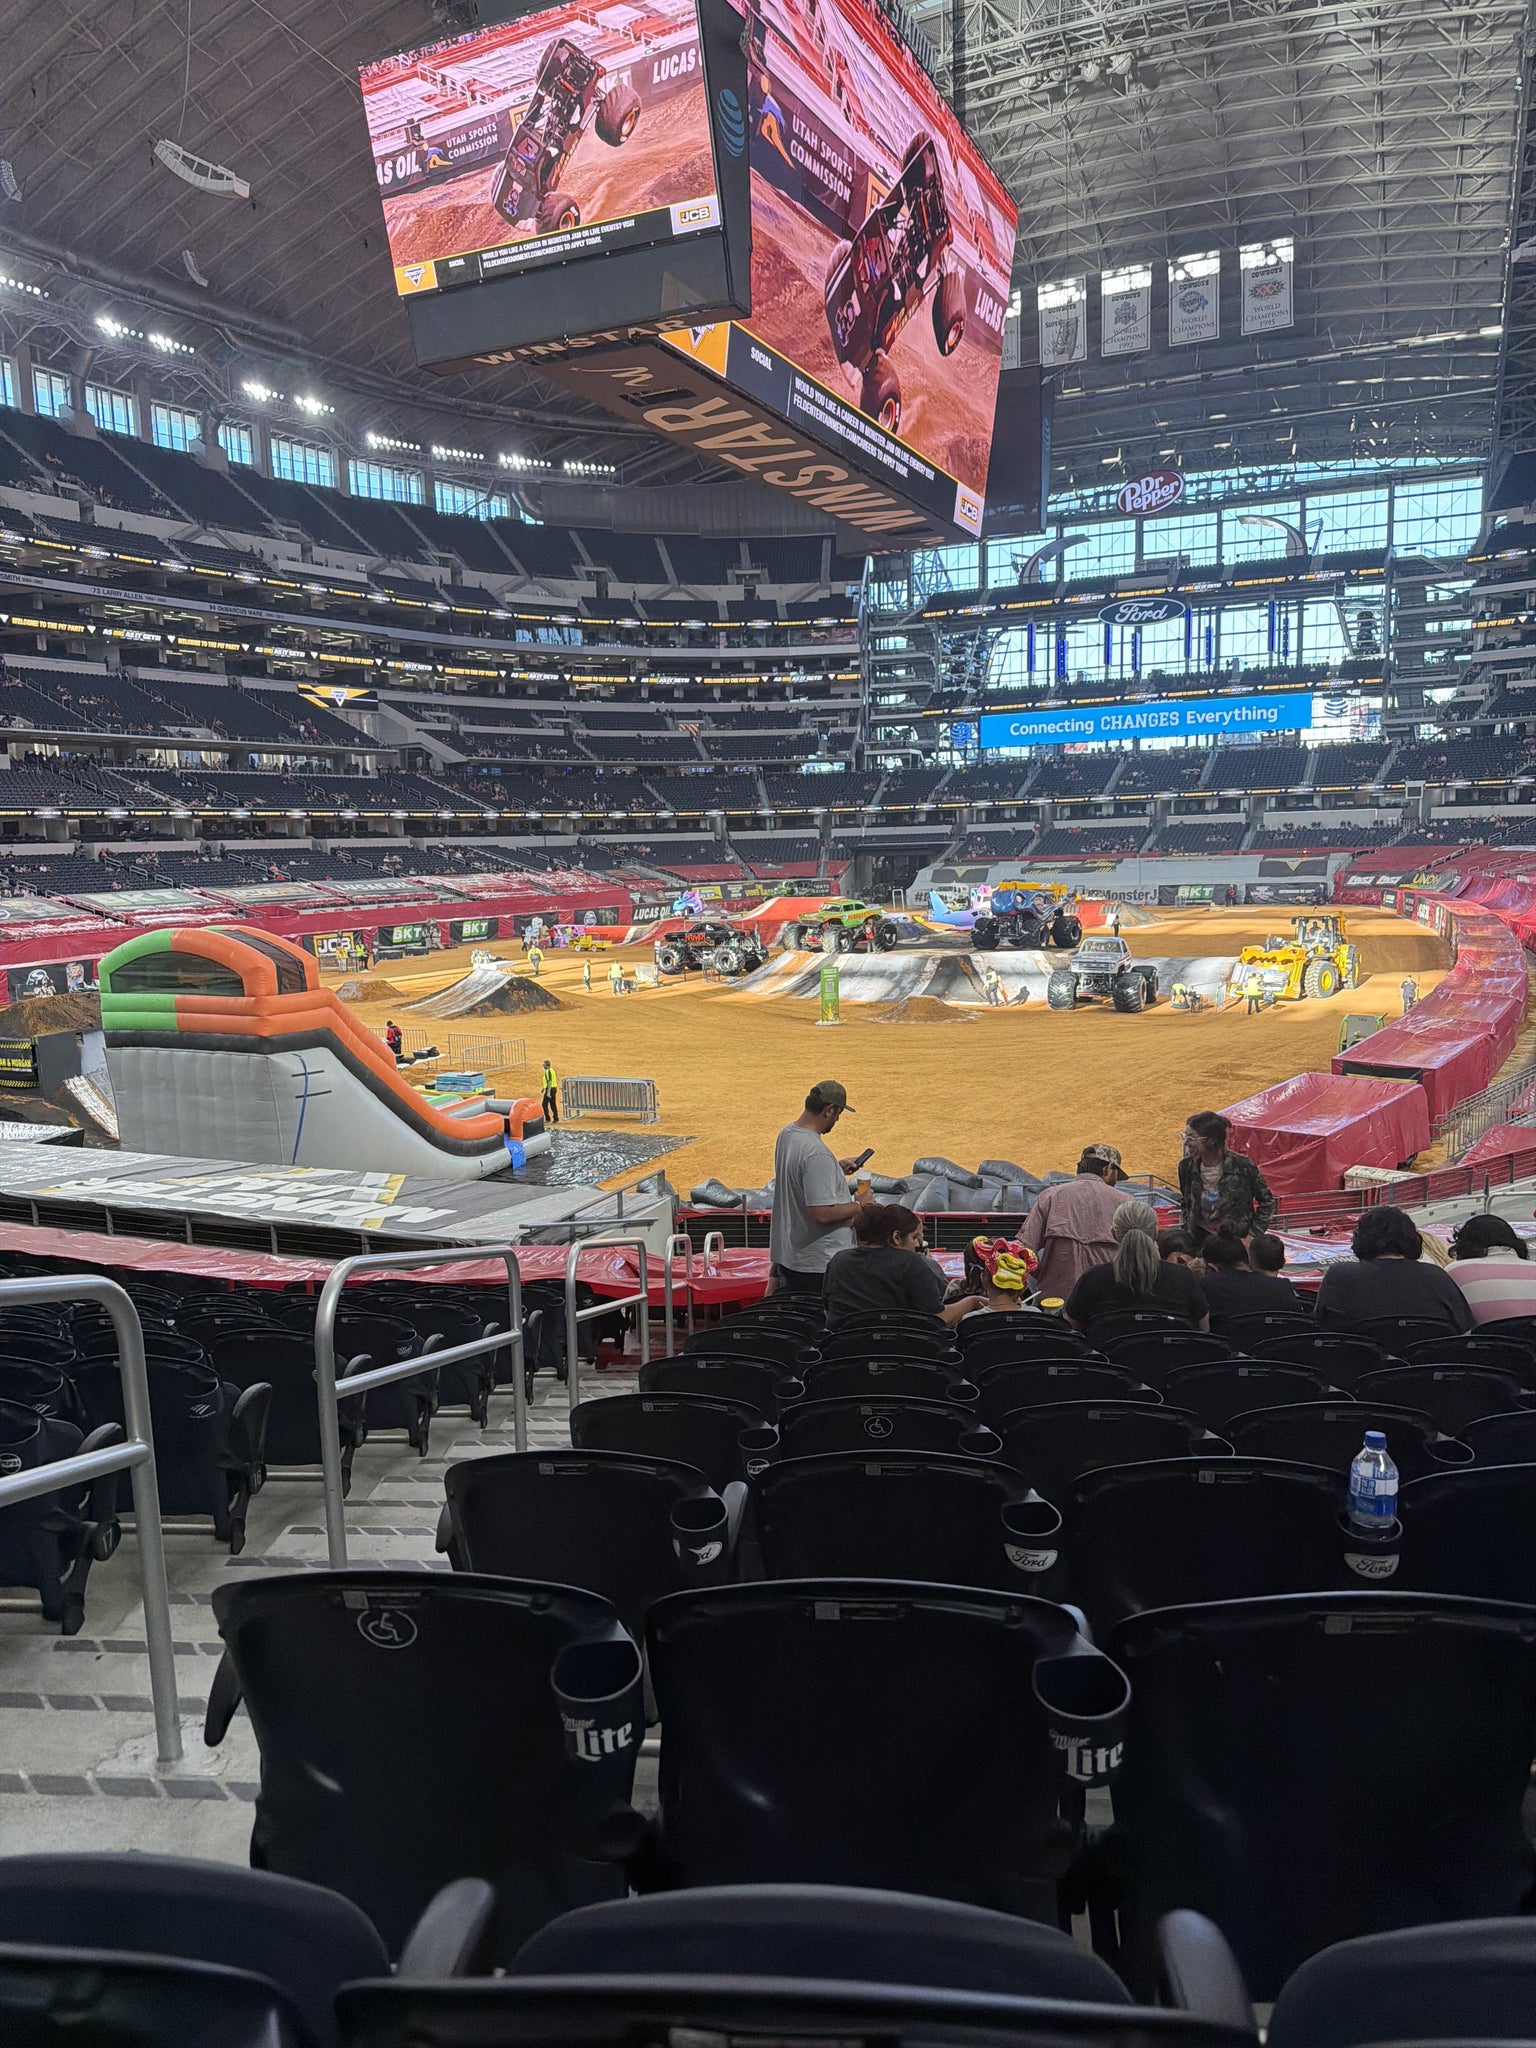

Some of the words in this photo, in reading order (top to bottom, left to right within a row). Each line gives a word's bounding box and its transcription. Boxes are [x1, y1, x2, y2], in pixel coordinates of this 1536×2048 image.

[652, 47, 697, 85] LUCAS
[446, 133, 467, 148] UTAH
[468, 122, 498, 140] SPORTS
[448, 134, 498, 160] COMMISSION
[792, 114, 818, 151] UTAH
[820, 140, 854, 183] SPORTS
[790, 139, 851, 203] COMMISSION
[681, 207, 710, 223] JCB
[498, 248, 508, 256] YOU
[508, 246, 519, 254] LIKE
[523, 240, 542, 250] CAREER
[548, 234, 571, 245] MONSTER
[571, 231, 582, 240] JAM
[590, 228, 601, 236] LIVE
[622, 219, 635, 228] VISIT
[571, 239, 586, 249] APPLY
[1251, 267, 1283, 278] COWBOYS
[974, 287, 1003, 332] LUCAS
[1245, 310, 1289, 323] CHAMPIONS
[1253, 303, 1281, 313] WORLD
[1173, 322, 1215, 333] CHAMPIONS
[1180, 314, 1207, 324] WORLD
[1106, 333, 1146, 345] CHAMPIONS
[1113, 326, 1139, 336] WORLD
[750, 346, 773, 371] SOCIAL
[795, 376, 814, 399] WOULD
[814, 390, 826, 407] YOU
[825, 398, 837, 414] LIKE
[841, 408, 859, 430] CAREER
[864, 425, 886, 447] MONSTER
[885, 439, 895, 454] JAM
[1140, 476, 1164, 495] Dr
[1122, 481, 1180, 513] Pepper
[961, 501, 978, 521] JCB
[102, 589, 122, 597] LARRY
[123, 591, 143, 600] ALLEN
[1115, 602, 1169, 623] Ford
[11, 616, 39, 628] WELCOME
[39, 620, 47, 628] TO
[47, 621, 57, 630] THE
[58, 623, 67, 631] PIT
[67, 624, 85, 633] PARTY
[103, 628, 112, 636] AS
[112, 629, 124, 637] BIG
[142, 633, 161, 641] GETS!
[177, 637, 200, 646] WELCOME
[225, 643, 240, 651] PARTY
[1009, 718, 1094, 736] Connecting
[1101, 711, 1180, 732] CHANGES
[1177, 885, 1215, 900] BKT
[633, 906, 660, 920] LUCAS
[392, 926, 423, 944] BKT
[462, 920, 489, 937] BKT
[318, 937, 352, 954] JCB
[11, 1058, 32, 1068] MORGAN
[1011, 1550, 1050, 1569] Ford
[1356, 1560, 1392, 1574] Ford
[576, 1722, 633, 1762] Lite
[1063, 1742, 1124, 1781] Lite
